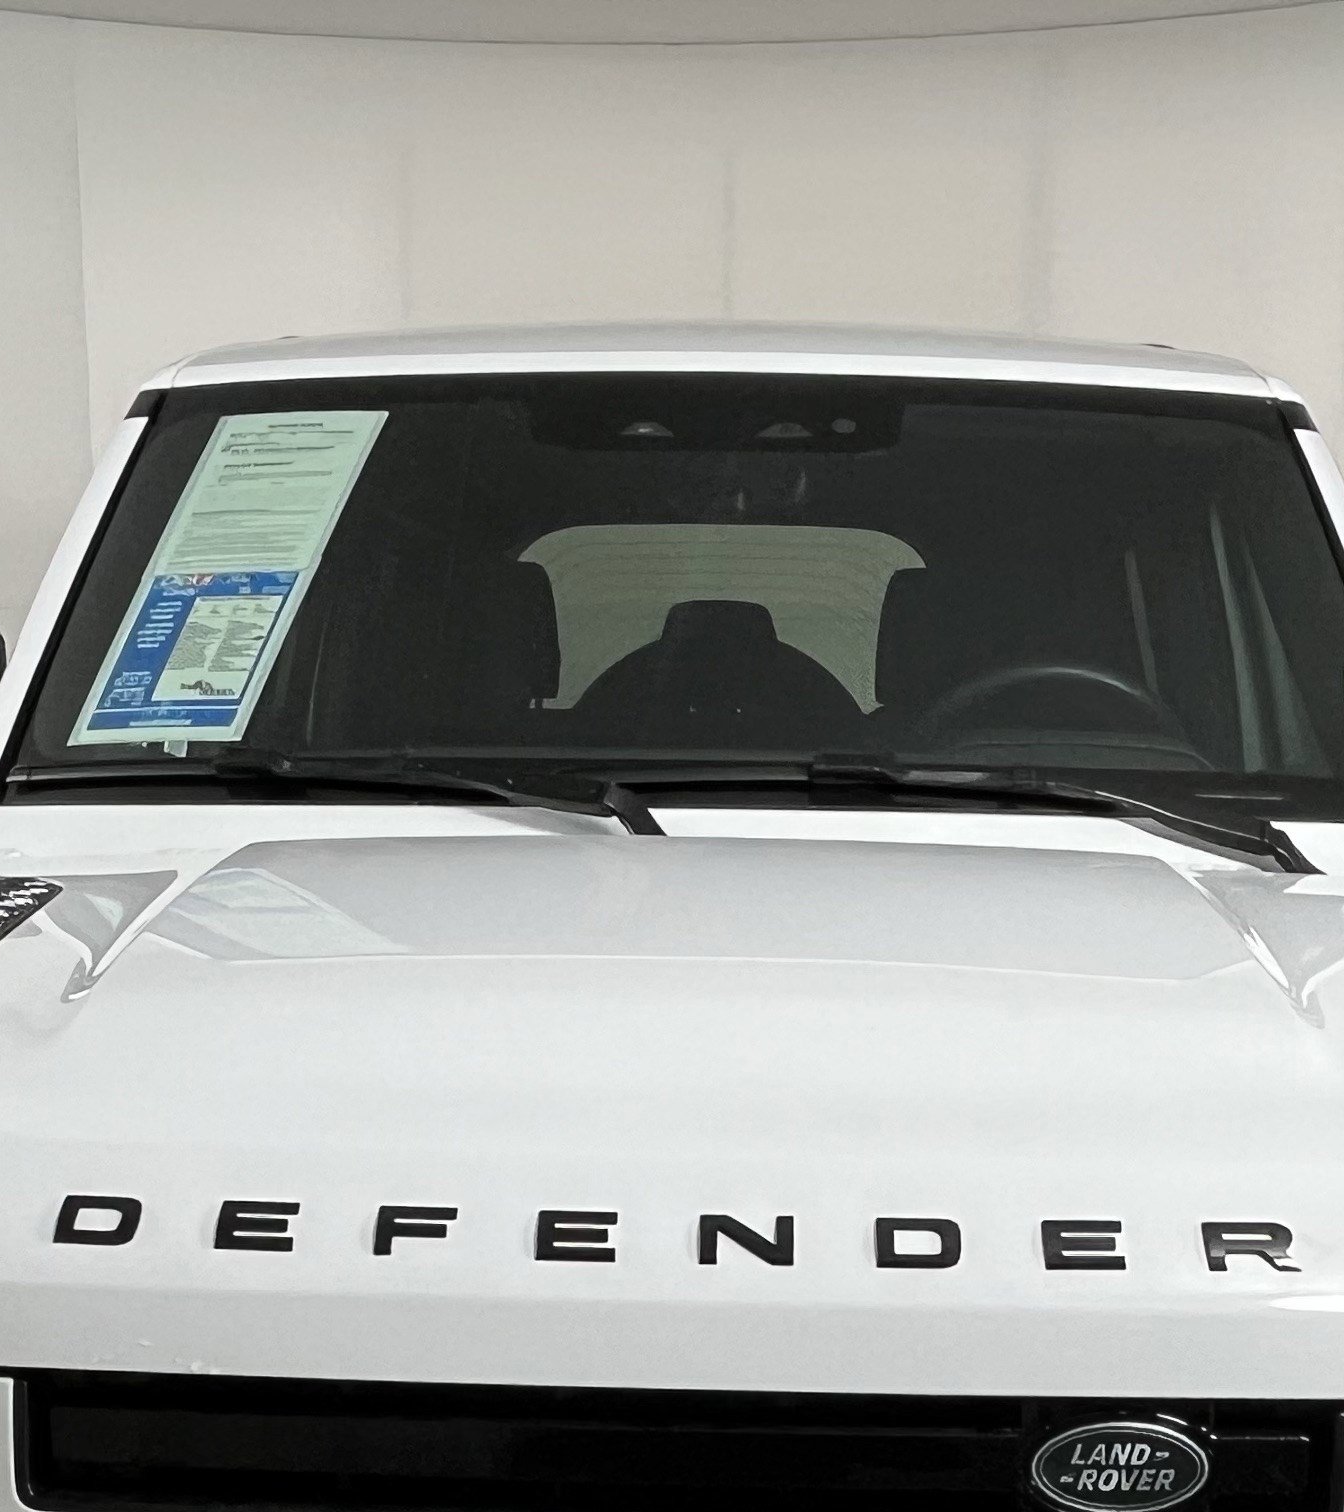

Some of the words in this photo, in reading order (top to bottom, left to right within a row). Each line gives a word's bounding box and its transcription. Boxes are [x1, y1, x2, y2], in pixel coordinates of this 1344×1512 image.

[54, 1193, 1303, 1273] DEFENDER
[1070, 1443, 1152, 1465] LAND
[1076, 1468, 1176, 1492] ROVER
